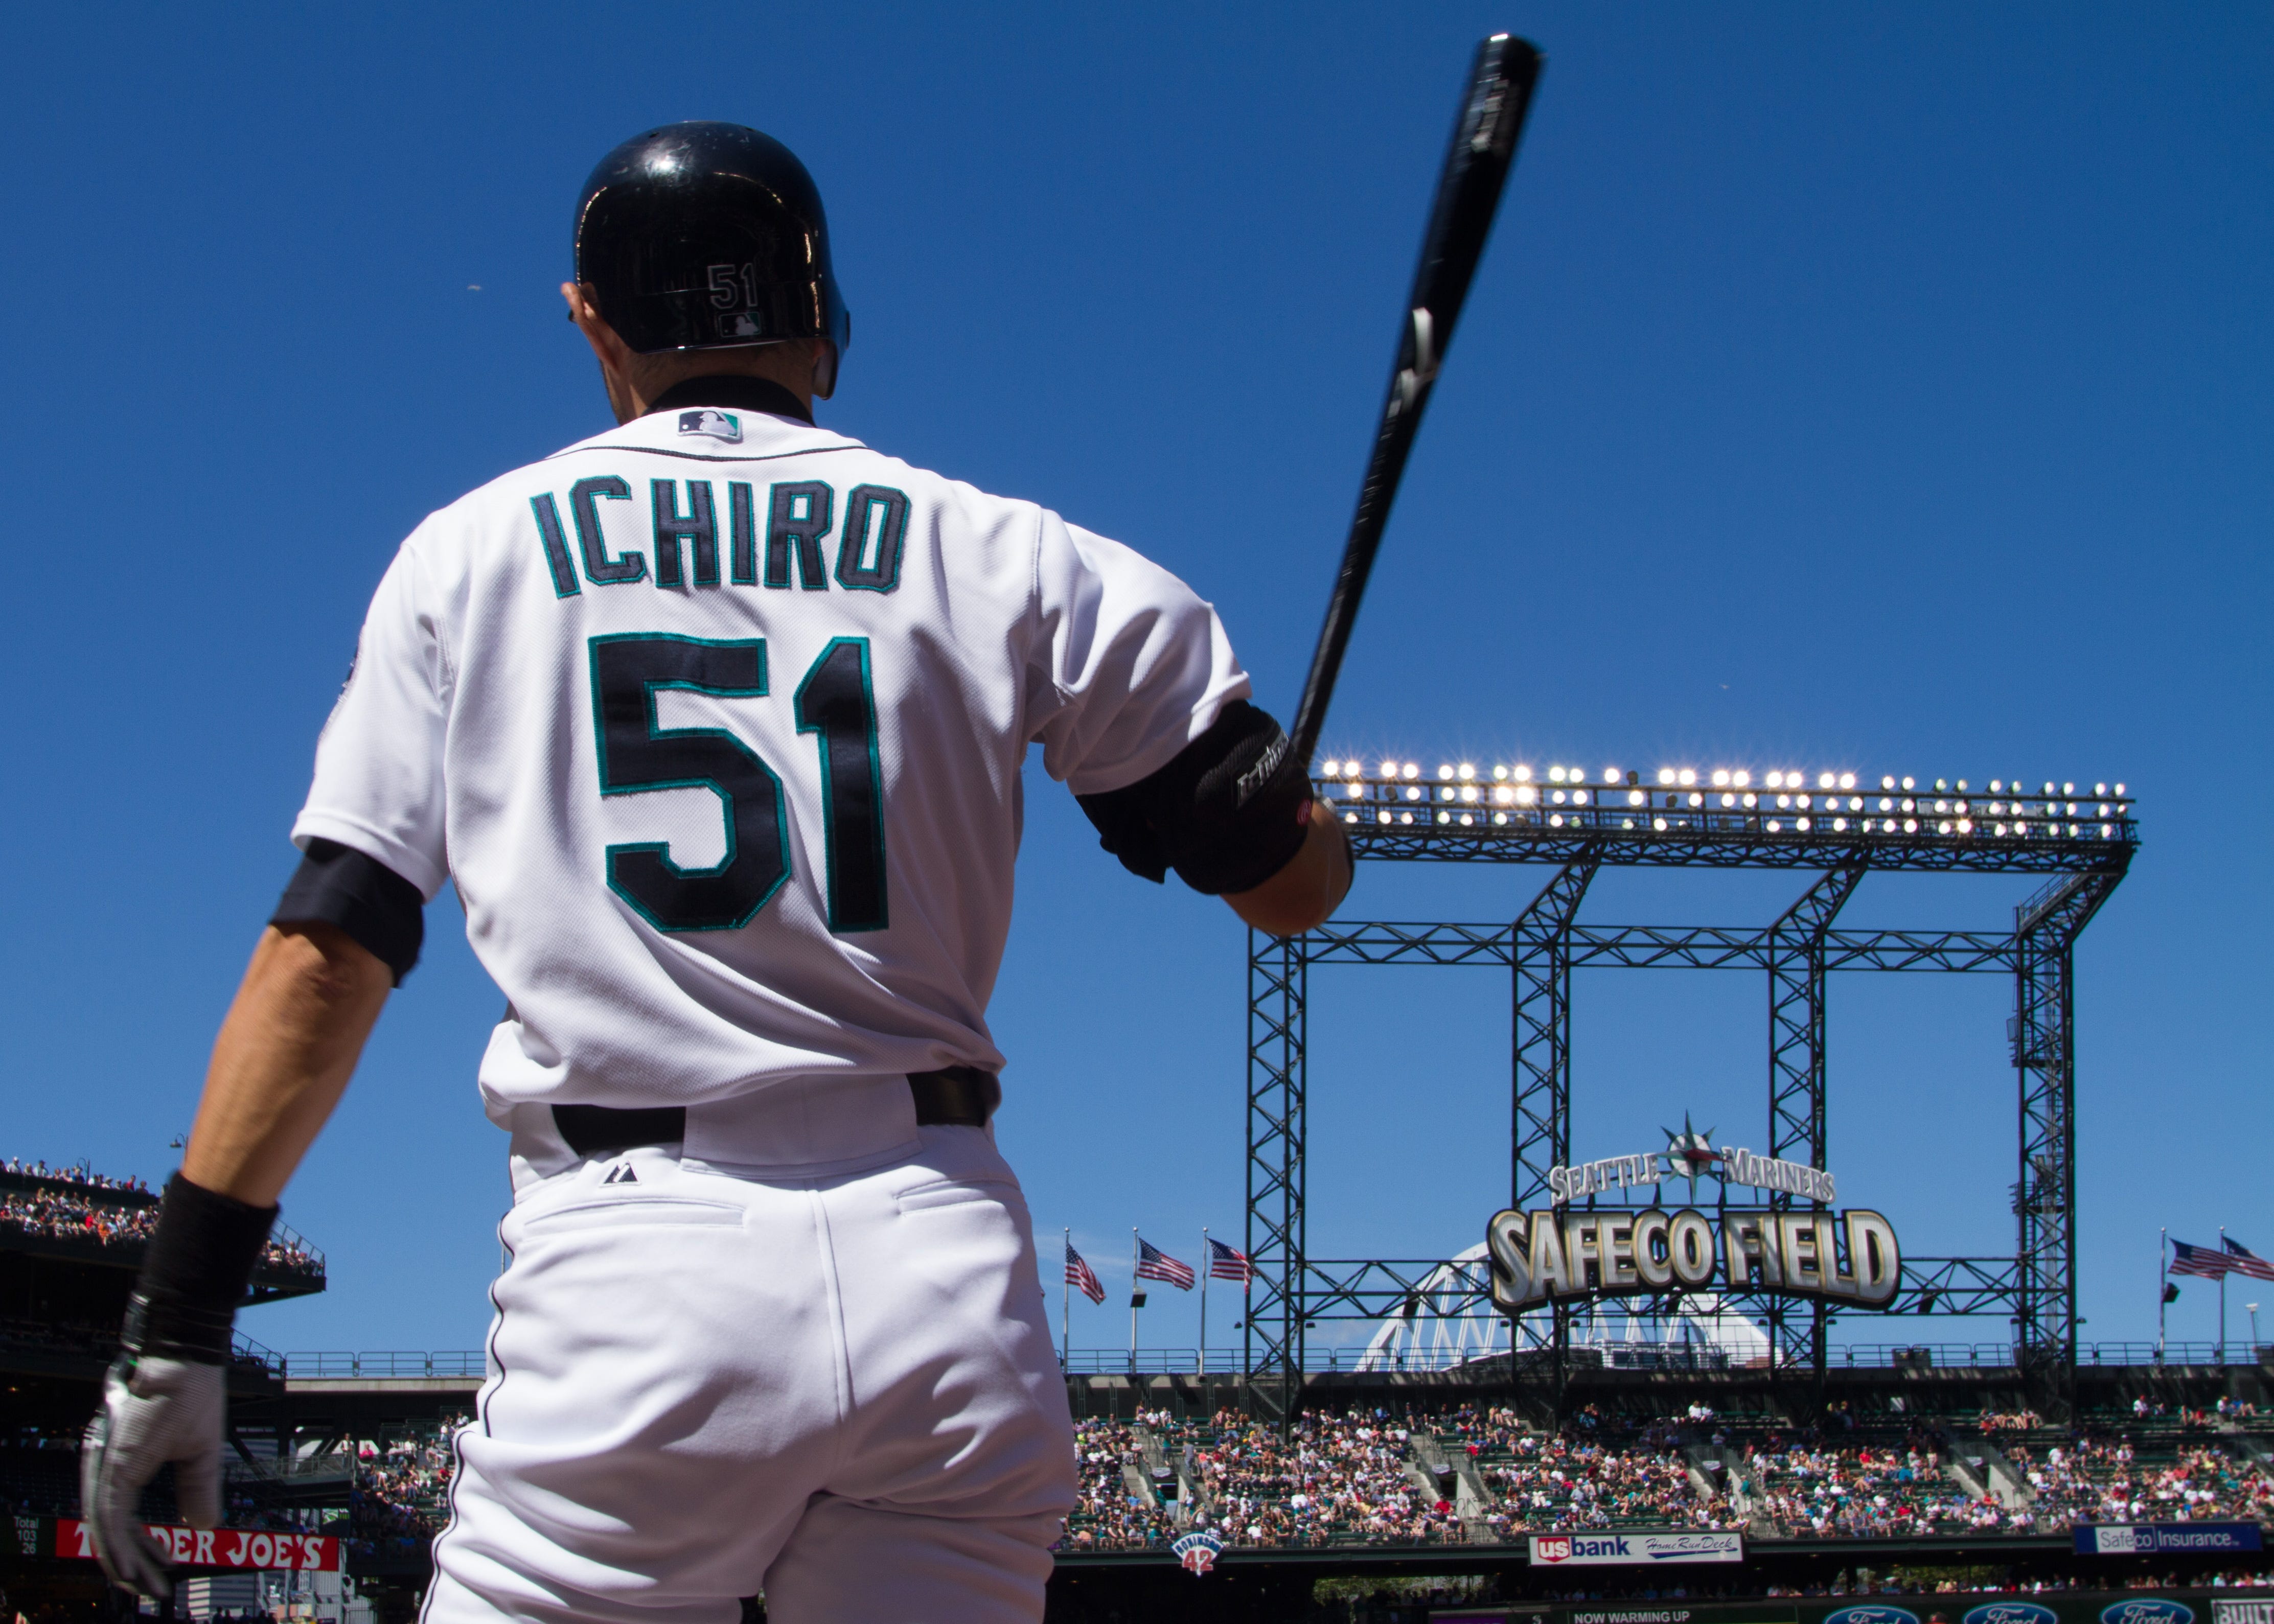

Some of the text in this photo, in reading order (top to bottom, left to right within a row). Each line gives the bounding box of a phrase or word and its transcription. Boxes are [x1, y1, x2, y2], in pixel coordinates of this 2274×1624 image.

[707, 263, 758, 309] 51
[530, 475, 911, 598] ICHIRO
[588, 632, 889, 933] 51
[1549, 1146, 1836, 1207] SEATTLE MARINERS
[1487, 1209, 1901, 1316] SAFECO FIELD
[13, 1516, 39, 1529] Total
[17, 1529, 37, 1542] 103
[2100, 1530, 2231, 1548] Safeco Insurance
[21, 1542, 37, 1555] 26
[74, 1522, 325, 1569] TDER JOE'S
[1182, 1549, 1213, 1571] 42
[1574, 1611, 1690, 1624] NOW WARMING UP
